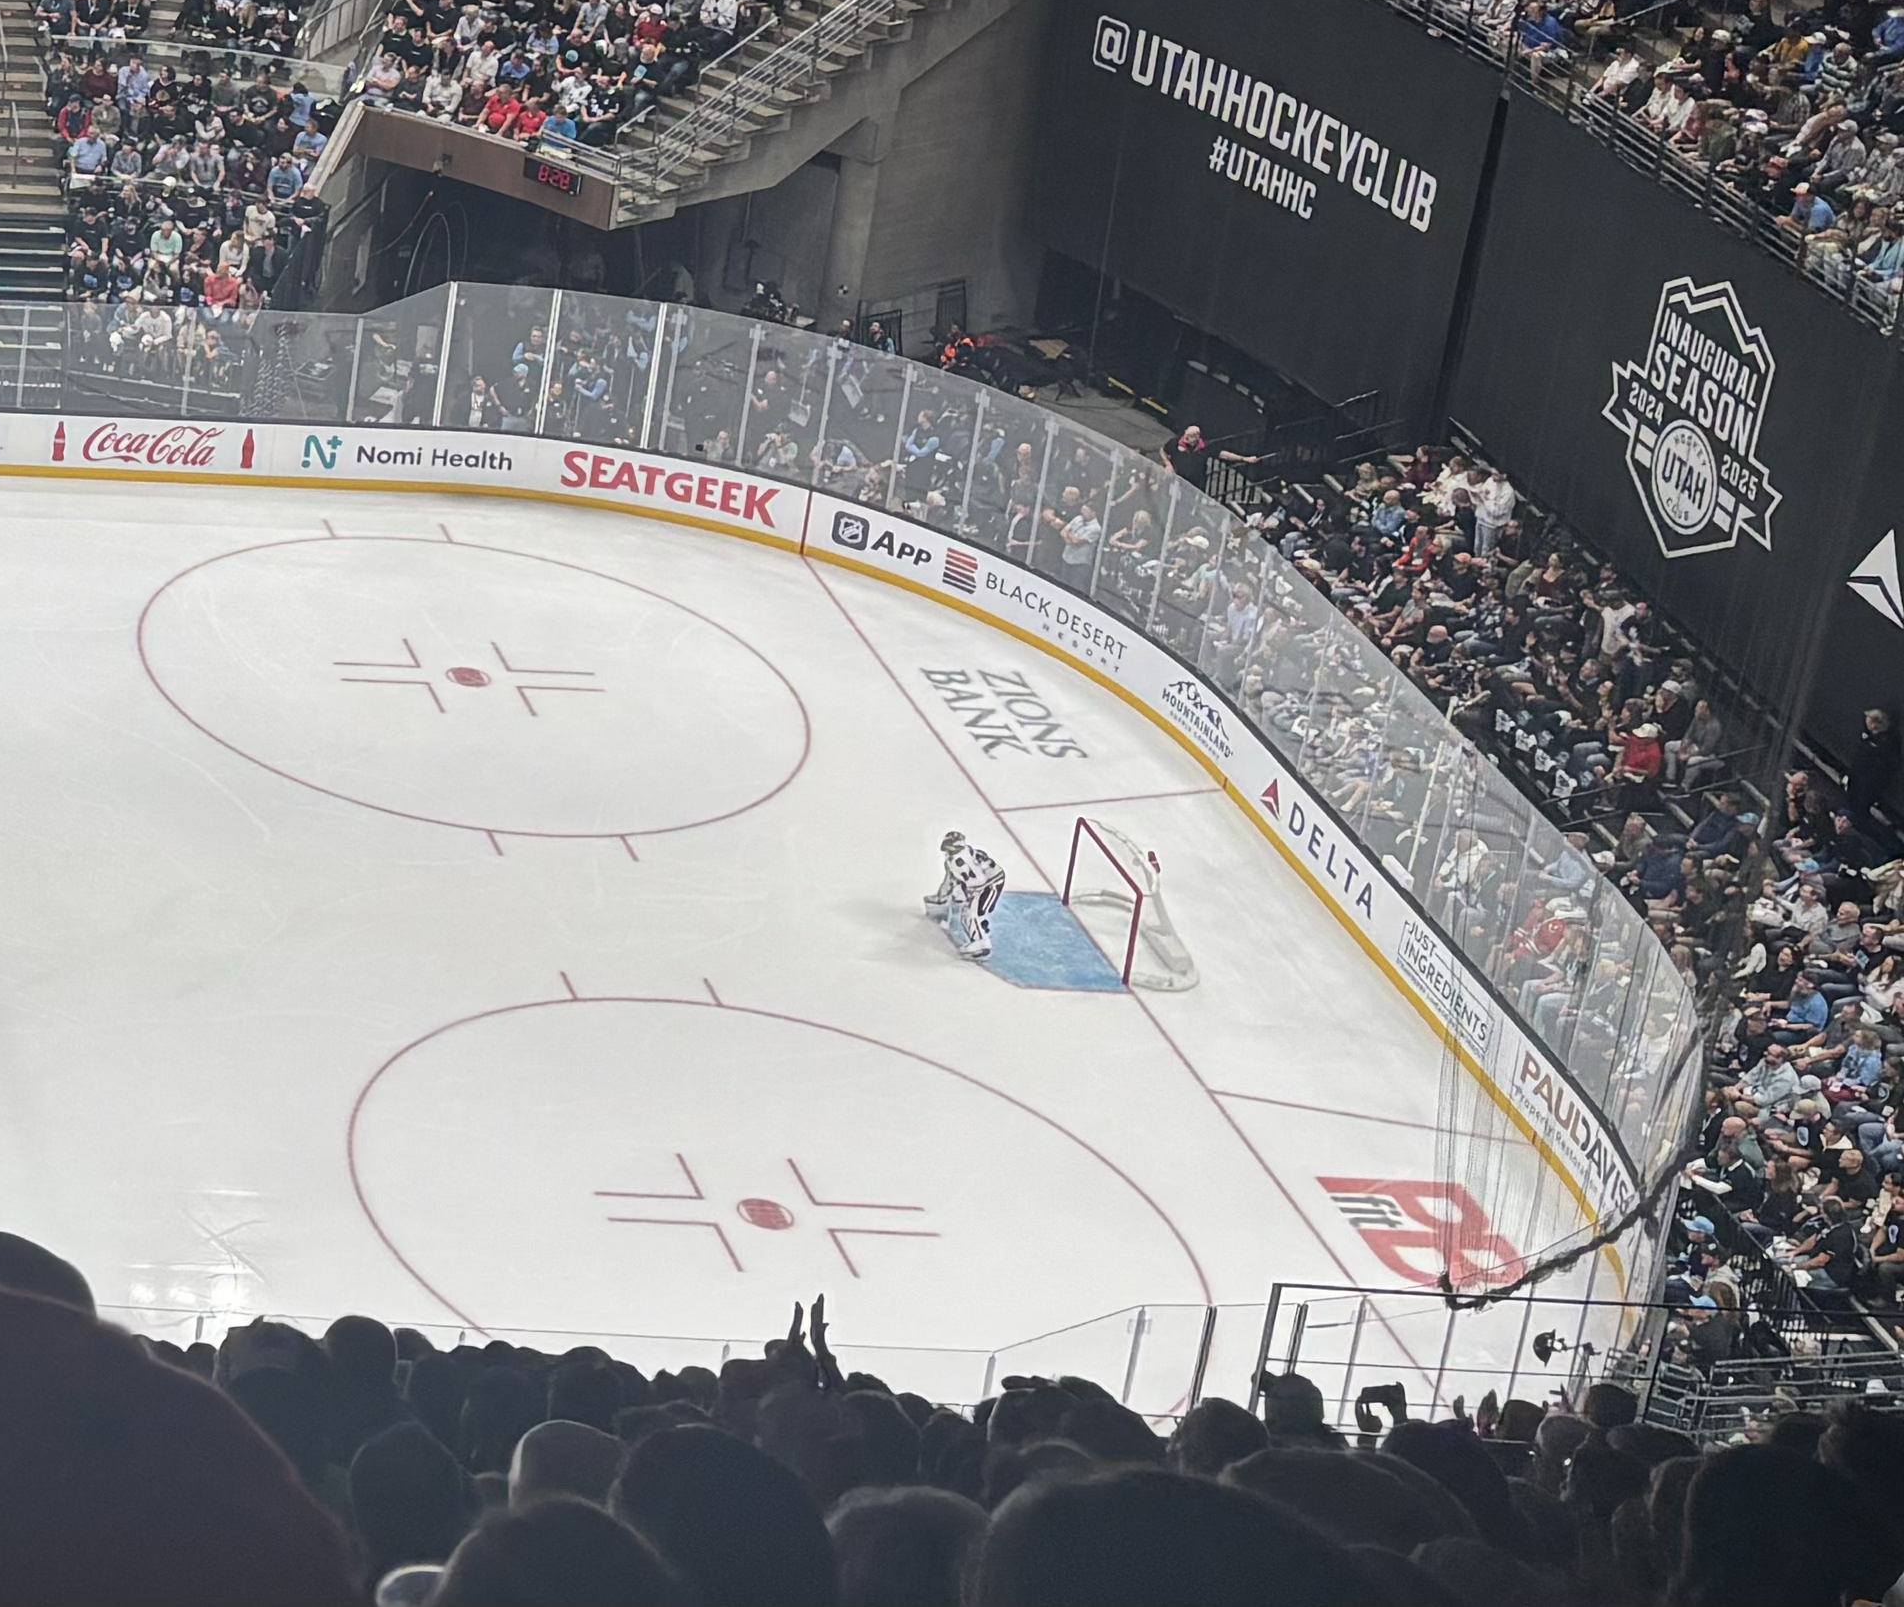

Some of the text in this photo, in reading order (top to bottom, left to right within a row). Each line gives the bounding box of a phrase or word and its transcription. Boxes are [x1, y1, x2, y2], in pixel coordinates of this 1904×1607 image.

[1093, 15, 1440, 234] @UTAHHOCKEYCLUB
[1209, 134, 1316, 221] #UTAHHC
[1628, 381, 1665, 426] 2024
[1651, 343, 1754, 456] SEASON
[1660, 308, 1758, 409] INAUGURAL
[83, 421, 226, 467] Coca-Cola
[356, 444, 513, 472] Nomi Health
[1662, 447, 1709, 510] UTAH
[1719, 454, 1759, 502] 2025
[560, 450, 783, 529] SEATGEEK
[985, 571, 1128, 661] BLACK DESERT
[920, 667, 1031, 760] BANK
[977, 670, 1089, 761] ZIONS
[1287, 801, 1376, 920] DELTA
[1406, 920, 1437, 956] JUST
[1403, 935, 1489, 1044] INGREDIENTS
[1521, 1050, 1581, 1146] PAUL
